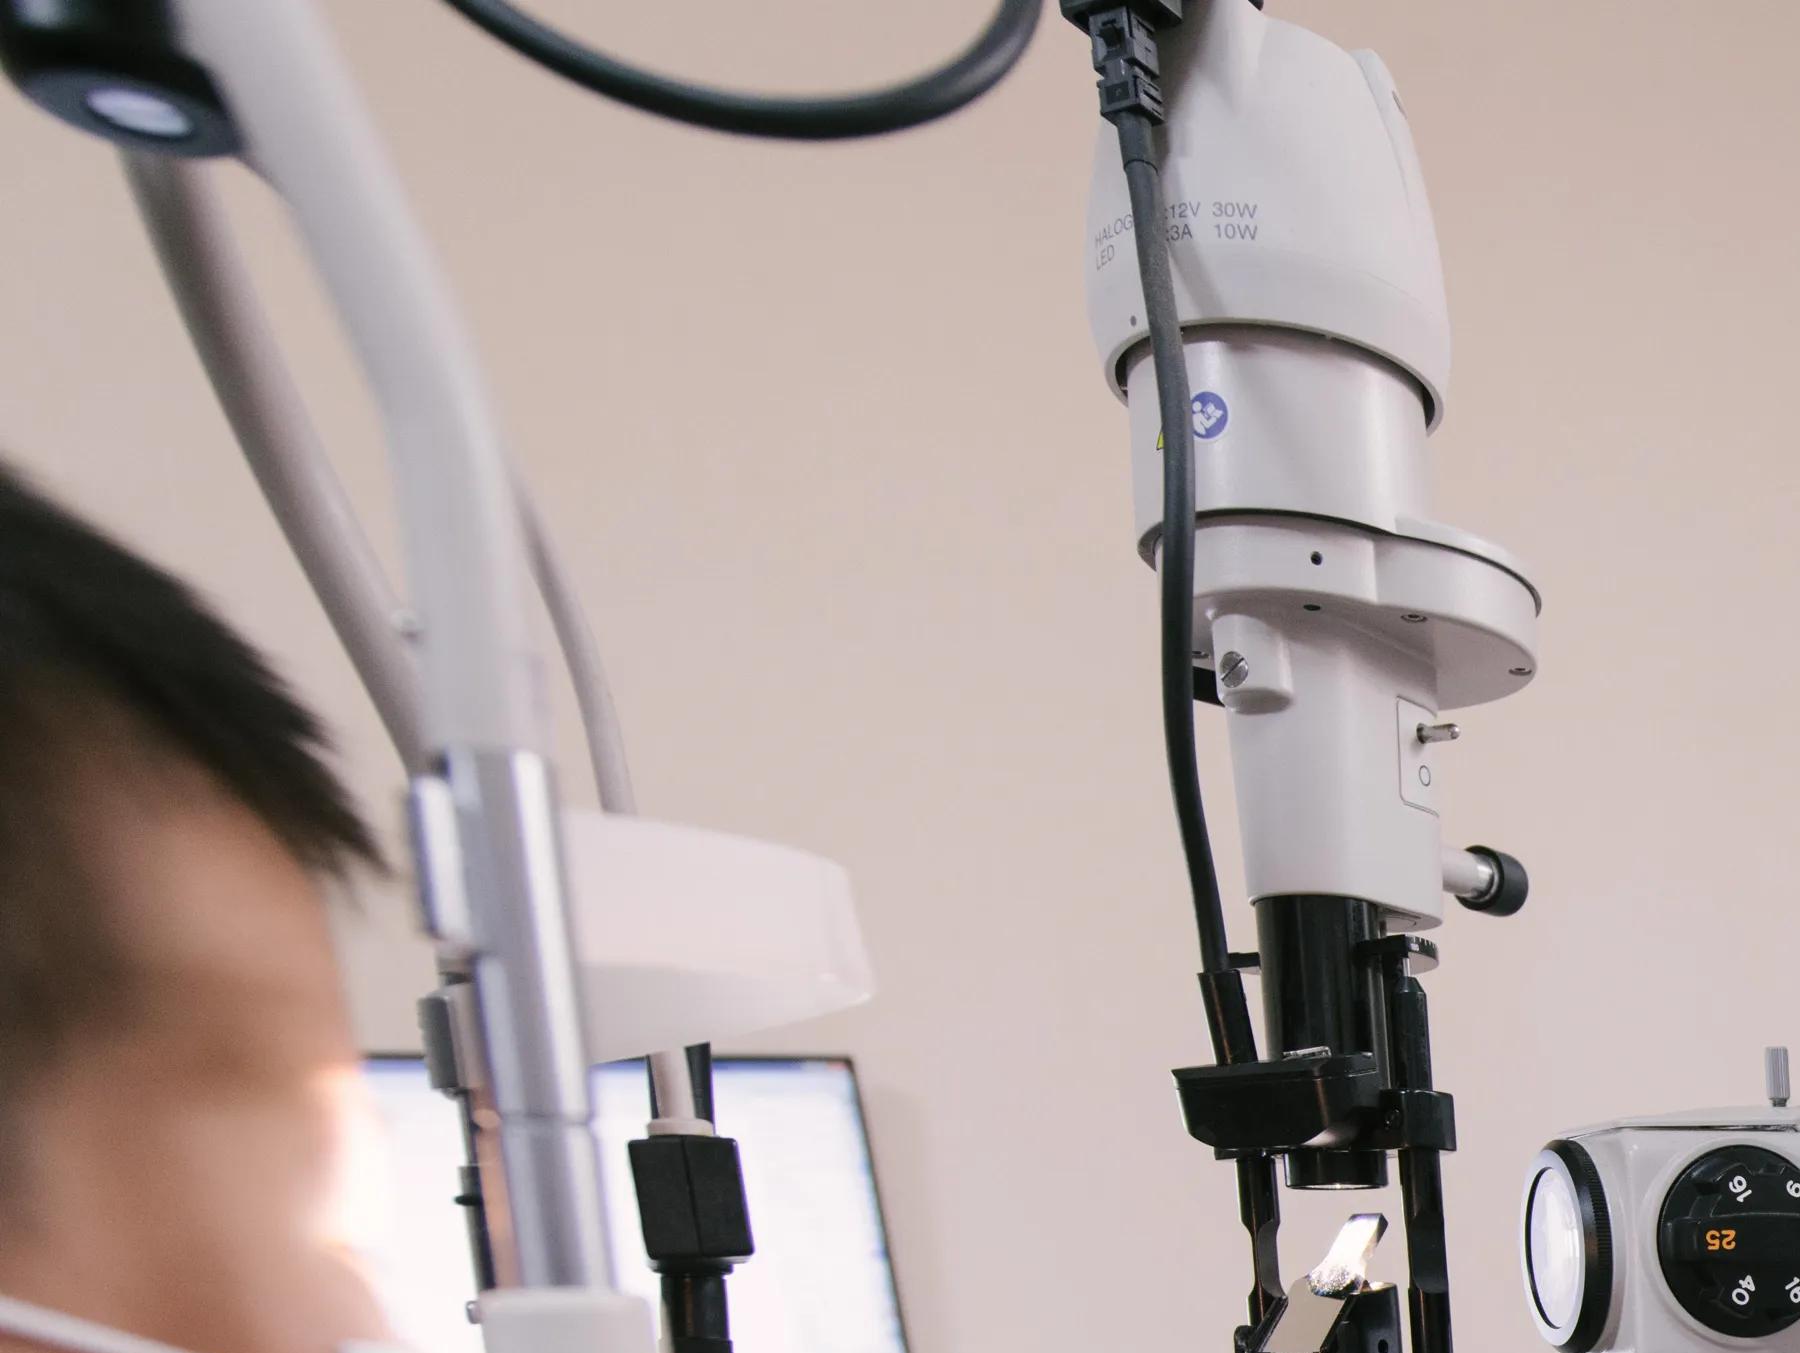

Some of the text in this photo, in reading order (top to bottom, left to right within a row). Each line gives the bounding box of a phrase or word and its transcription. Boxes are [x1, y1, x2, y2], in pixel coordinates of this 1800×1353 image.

[1095, 214, 1134, 246] HALOG
[1212, 201, 1258, 219] 30W
[1096, 244, 1115, 270] LED
[1214, 223, 1258, 240] 10W
[1728, 1175, 1752, 1203] 16
[1705, 1229, 1737, 1250] 25
[1731, 1274, 1756, 1305] 40
